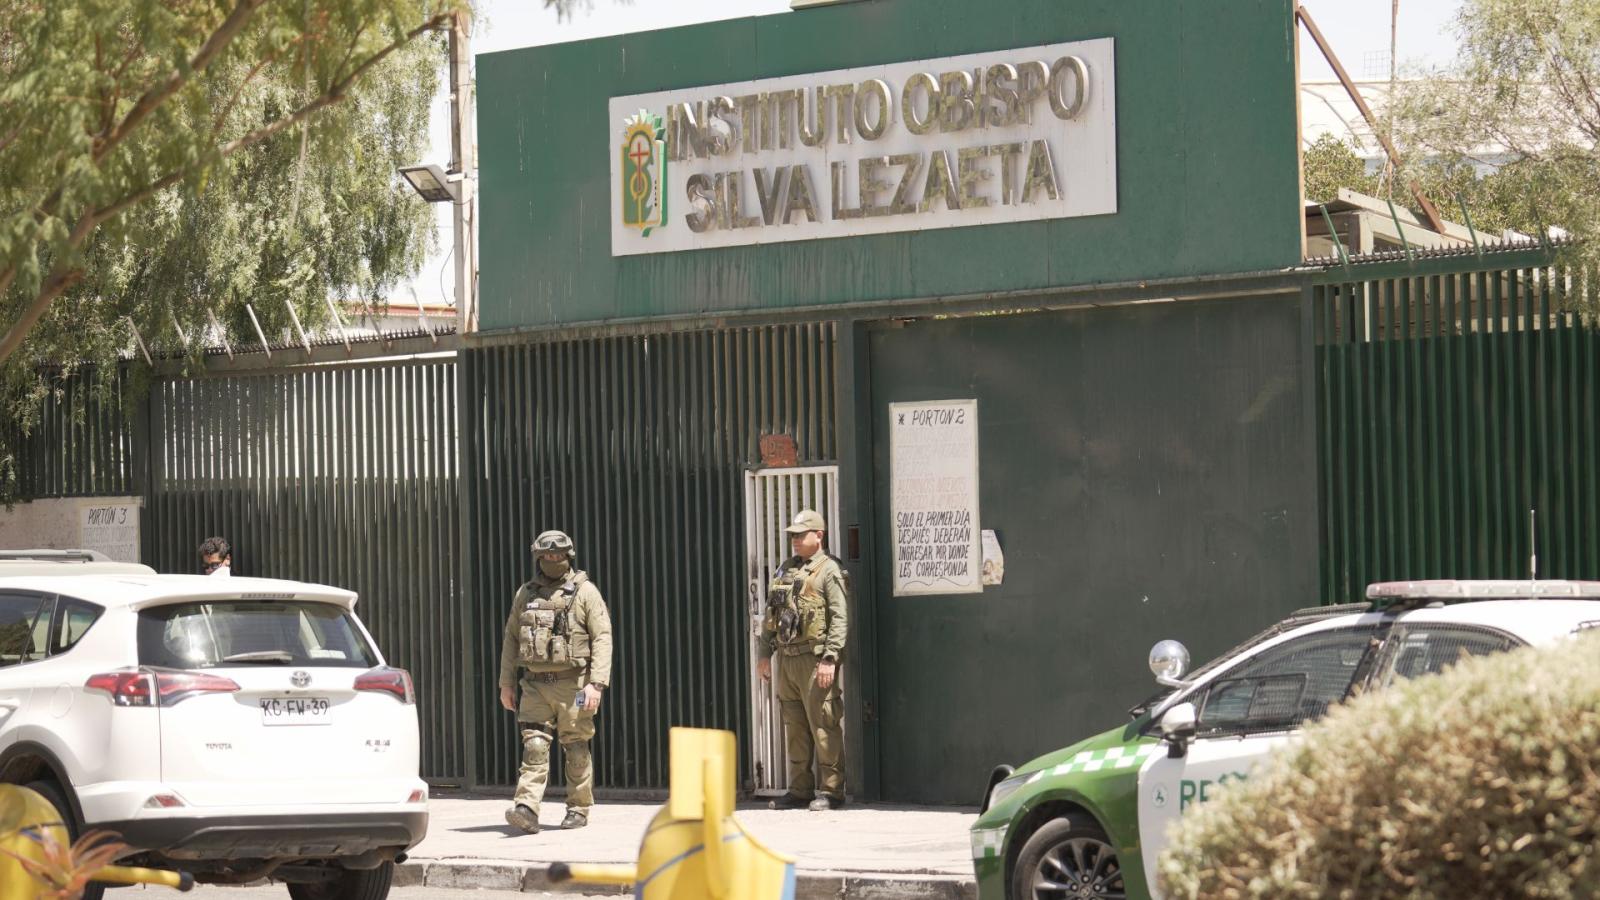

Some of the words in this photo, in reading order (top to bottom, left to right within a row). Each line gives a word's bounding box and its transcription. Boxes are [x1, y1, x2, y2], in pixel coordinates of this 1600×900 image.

[667, 79, 894, 162] INSTITUTO
[902, 56, 1092, 136] OBISPO
[685, 164, 818, 234] SILVA
[831, 139, 1065, 221] LEZAETA
[955, 408, 965, 425] 2
[119, 507, 128, 525] 3
[897, 511, 914, 528] SOLO
[916, 511, 924, 527] EL
[925, 511, 954, 527] PRIMER
[899, 544, 934, 561] INGRESAR
[948, 544, 969, 560] DONDE
[899, 561, 913, 578] LES
[916, 561, 968, 578] CORRESPONDA
